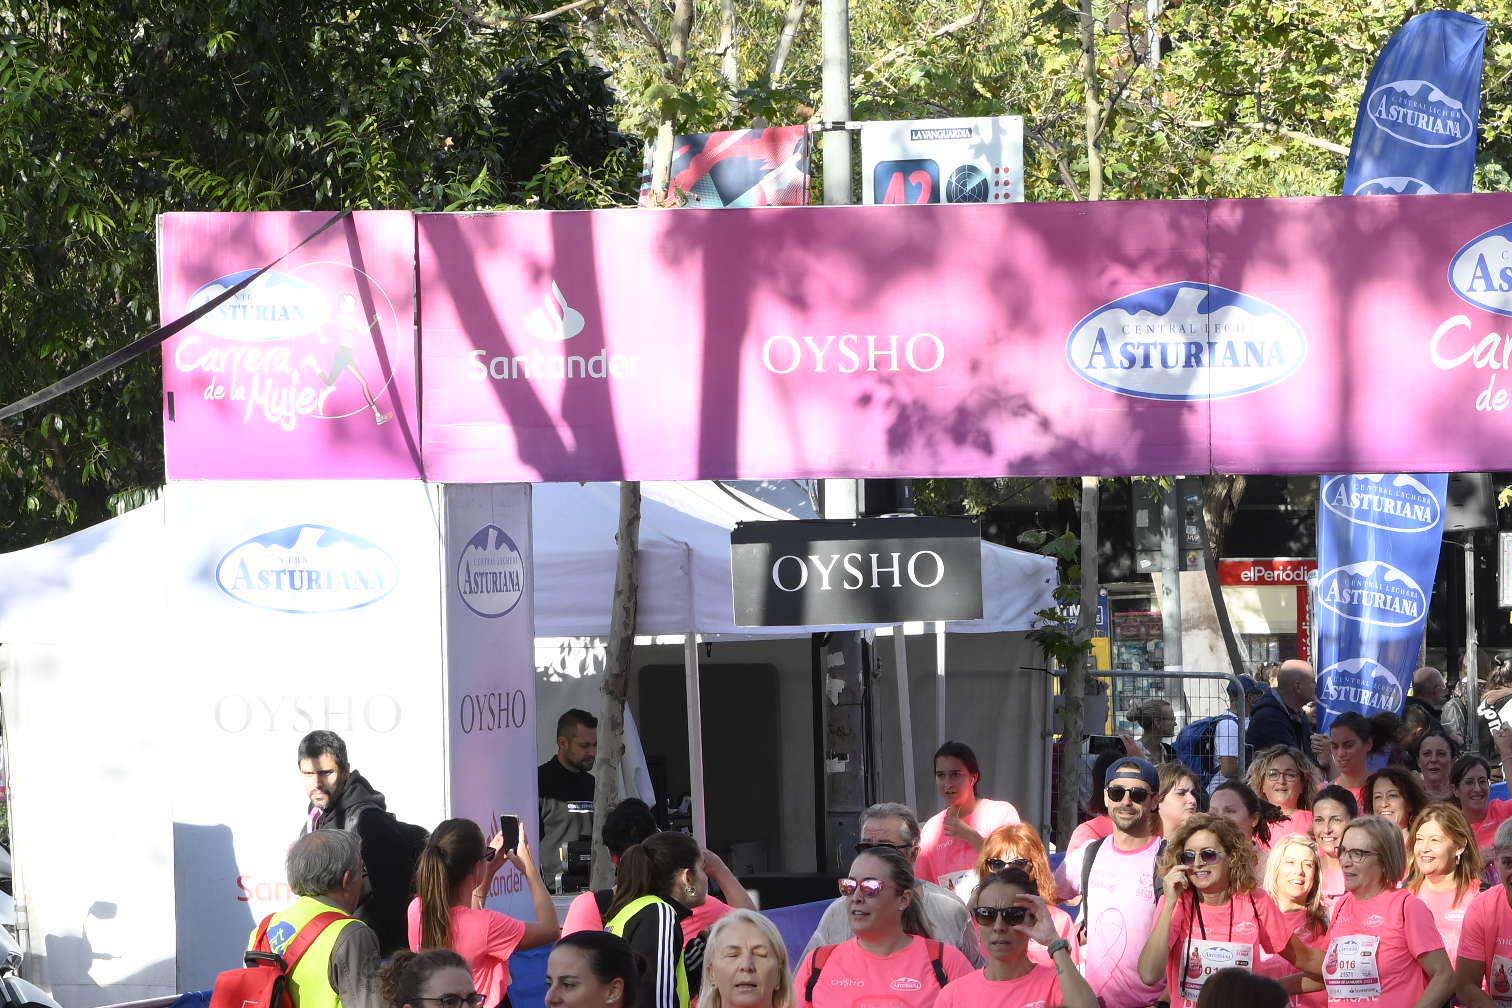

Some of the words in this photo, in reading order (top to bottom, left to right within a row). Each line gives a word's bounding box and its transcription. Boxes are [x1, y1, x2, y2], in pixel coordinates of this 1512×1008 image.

[1375, 94, 1462, 138] ASTURIANA
[1085, 327, 1286, 370] ASTURIANA
[1121, 323, 1196, 335] CENTRAL
[175, 336, 294, 374] Carrera
[468, 349, 640, 379] Santander
[761, 332, 945, 374] OYSHO
[204, 377, 225, 400] de
[230, 374, 247, 400] la
[244, 371, 336, 431] Mujer
[1475, 373, 1511, 411] de
[1332, 482, 1432, 523] ASTURIANA
[232, 557, 386, 591] ASTURIANA
[462, 568, 521, 595] ASTURIANA
[772, 550, 945, 592] OYSHO
[1241, 566, 1309, 582] elPeriódi
[1325, 578, 1418, 618] ASTURIANA
[214, 694, 402, 734] OYSHO
[460, 690, 526, 734] OYSHO
[1204, 966, 1219, 975] 01
[1340, 960, 1356, 969] 016
